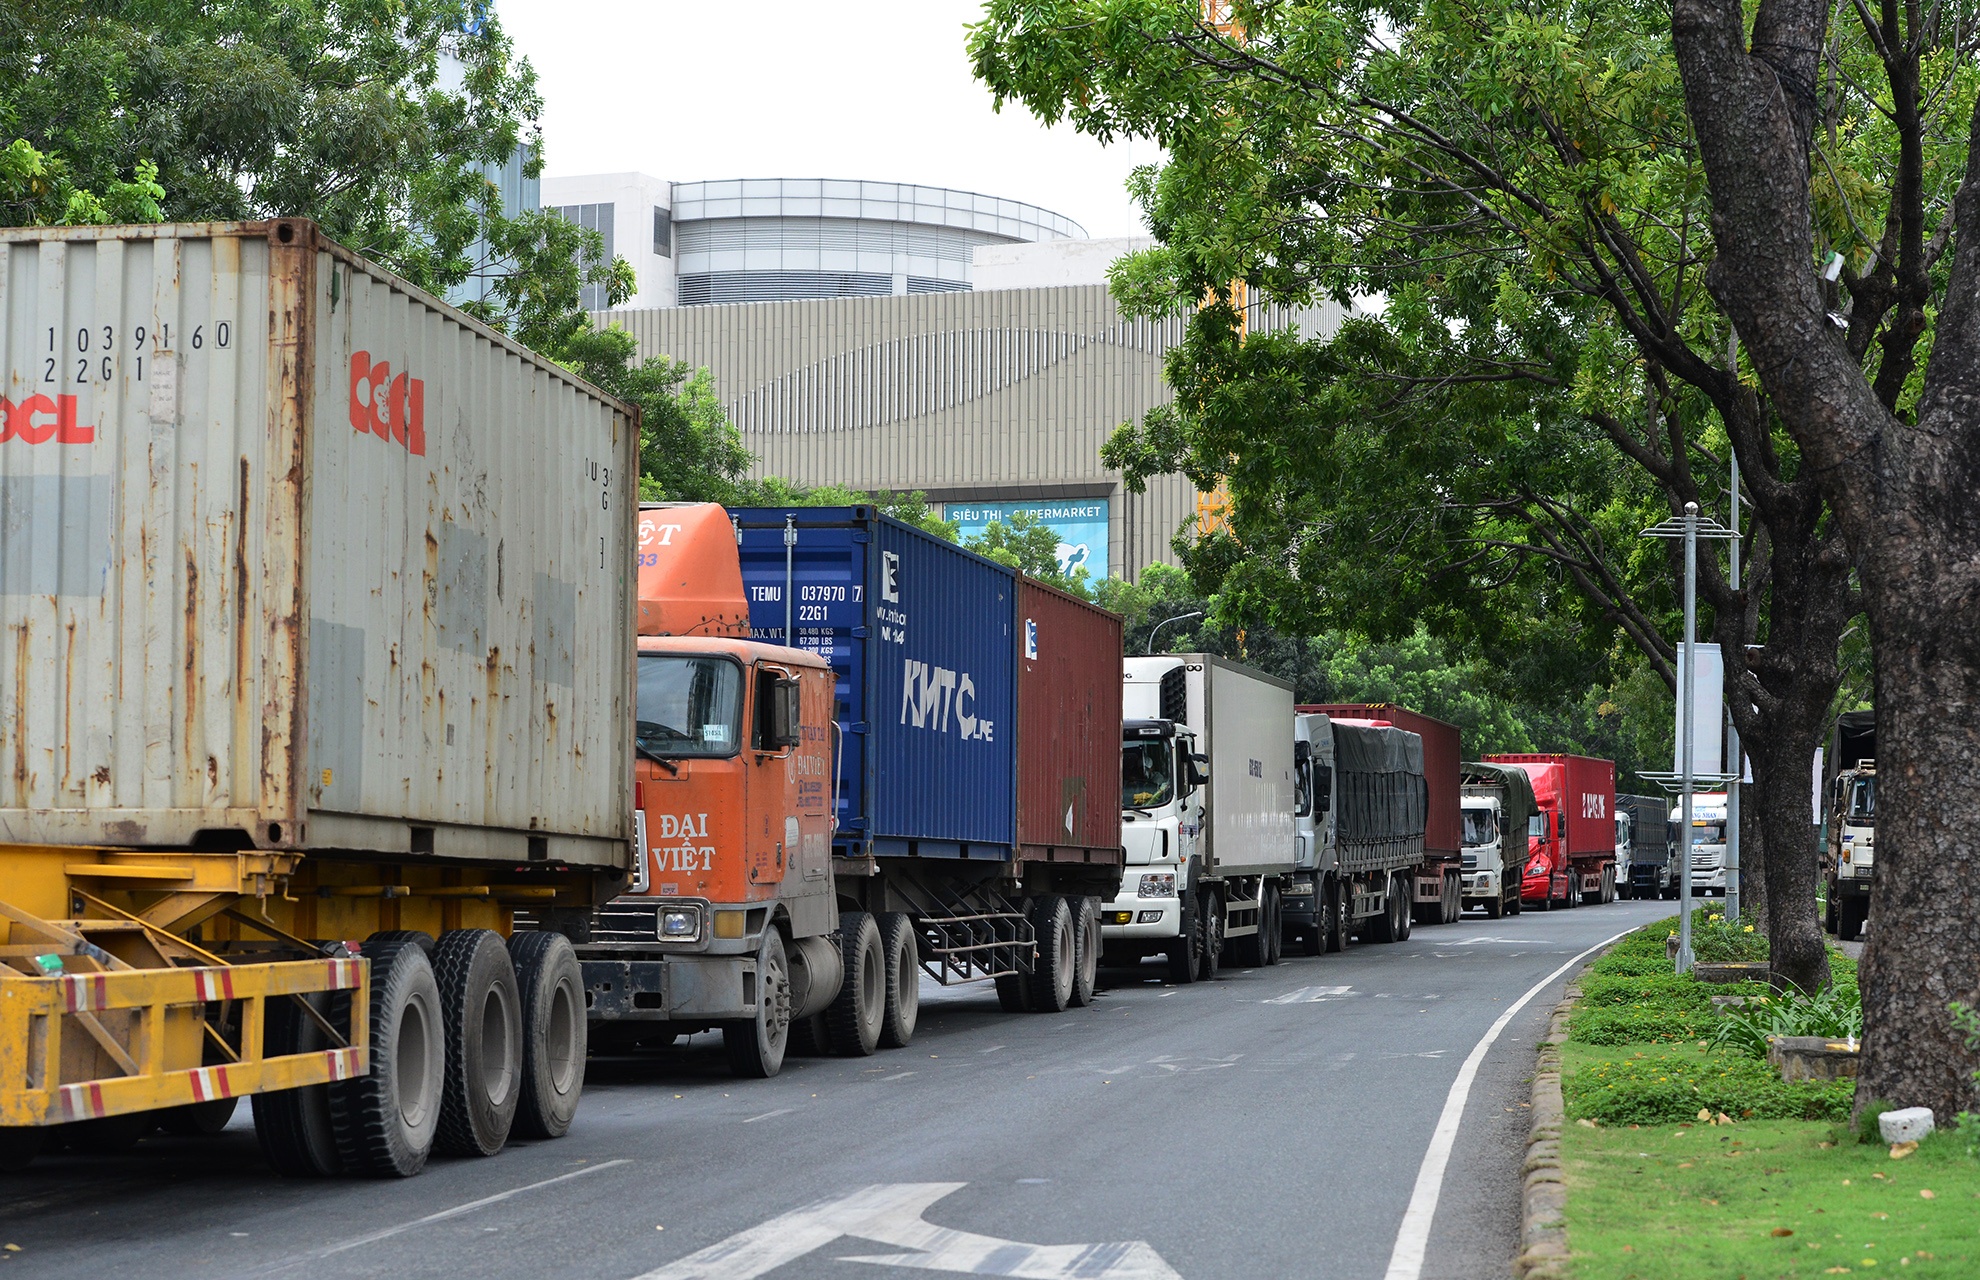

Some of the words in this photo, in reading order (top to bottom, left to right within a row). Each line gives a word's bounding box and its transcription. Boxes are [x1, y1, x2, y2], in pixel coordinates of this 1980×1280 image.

[952, 508, 980, 521] SIÊU
[982, 509, 1002, 522] THỊ
[751, 586, 781, 602] TEMU
[801, 585, 846, 601] 037970
[853, 585, 862, 602] 7
[799, 605, 828, 621] 22G1
[769, 627, 785, 639] WT.
[821, 627, 834, 636] KGS
[799, 637, 819, 646] 67.200
[821, 637, 833, 646] LBS
[821, 646, 834, 655] KGS
[901, 658, 975, 740] KMTC
[660, 813, 708, 841] ĐẠI
[652, 842, 716, 876] VIỆT
